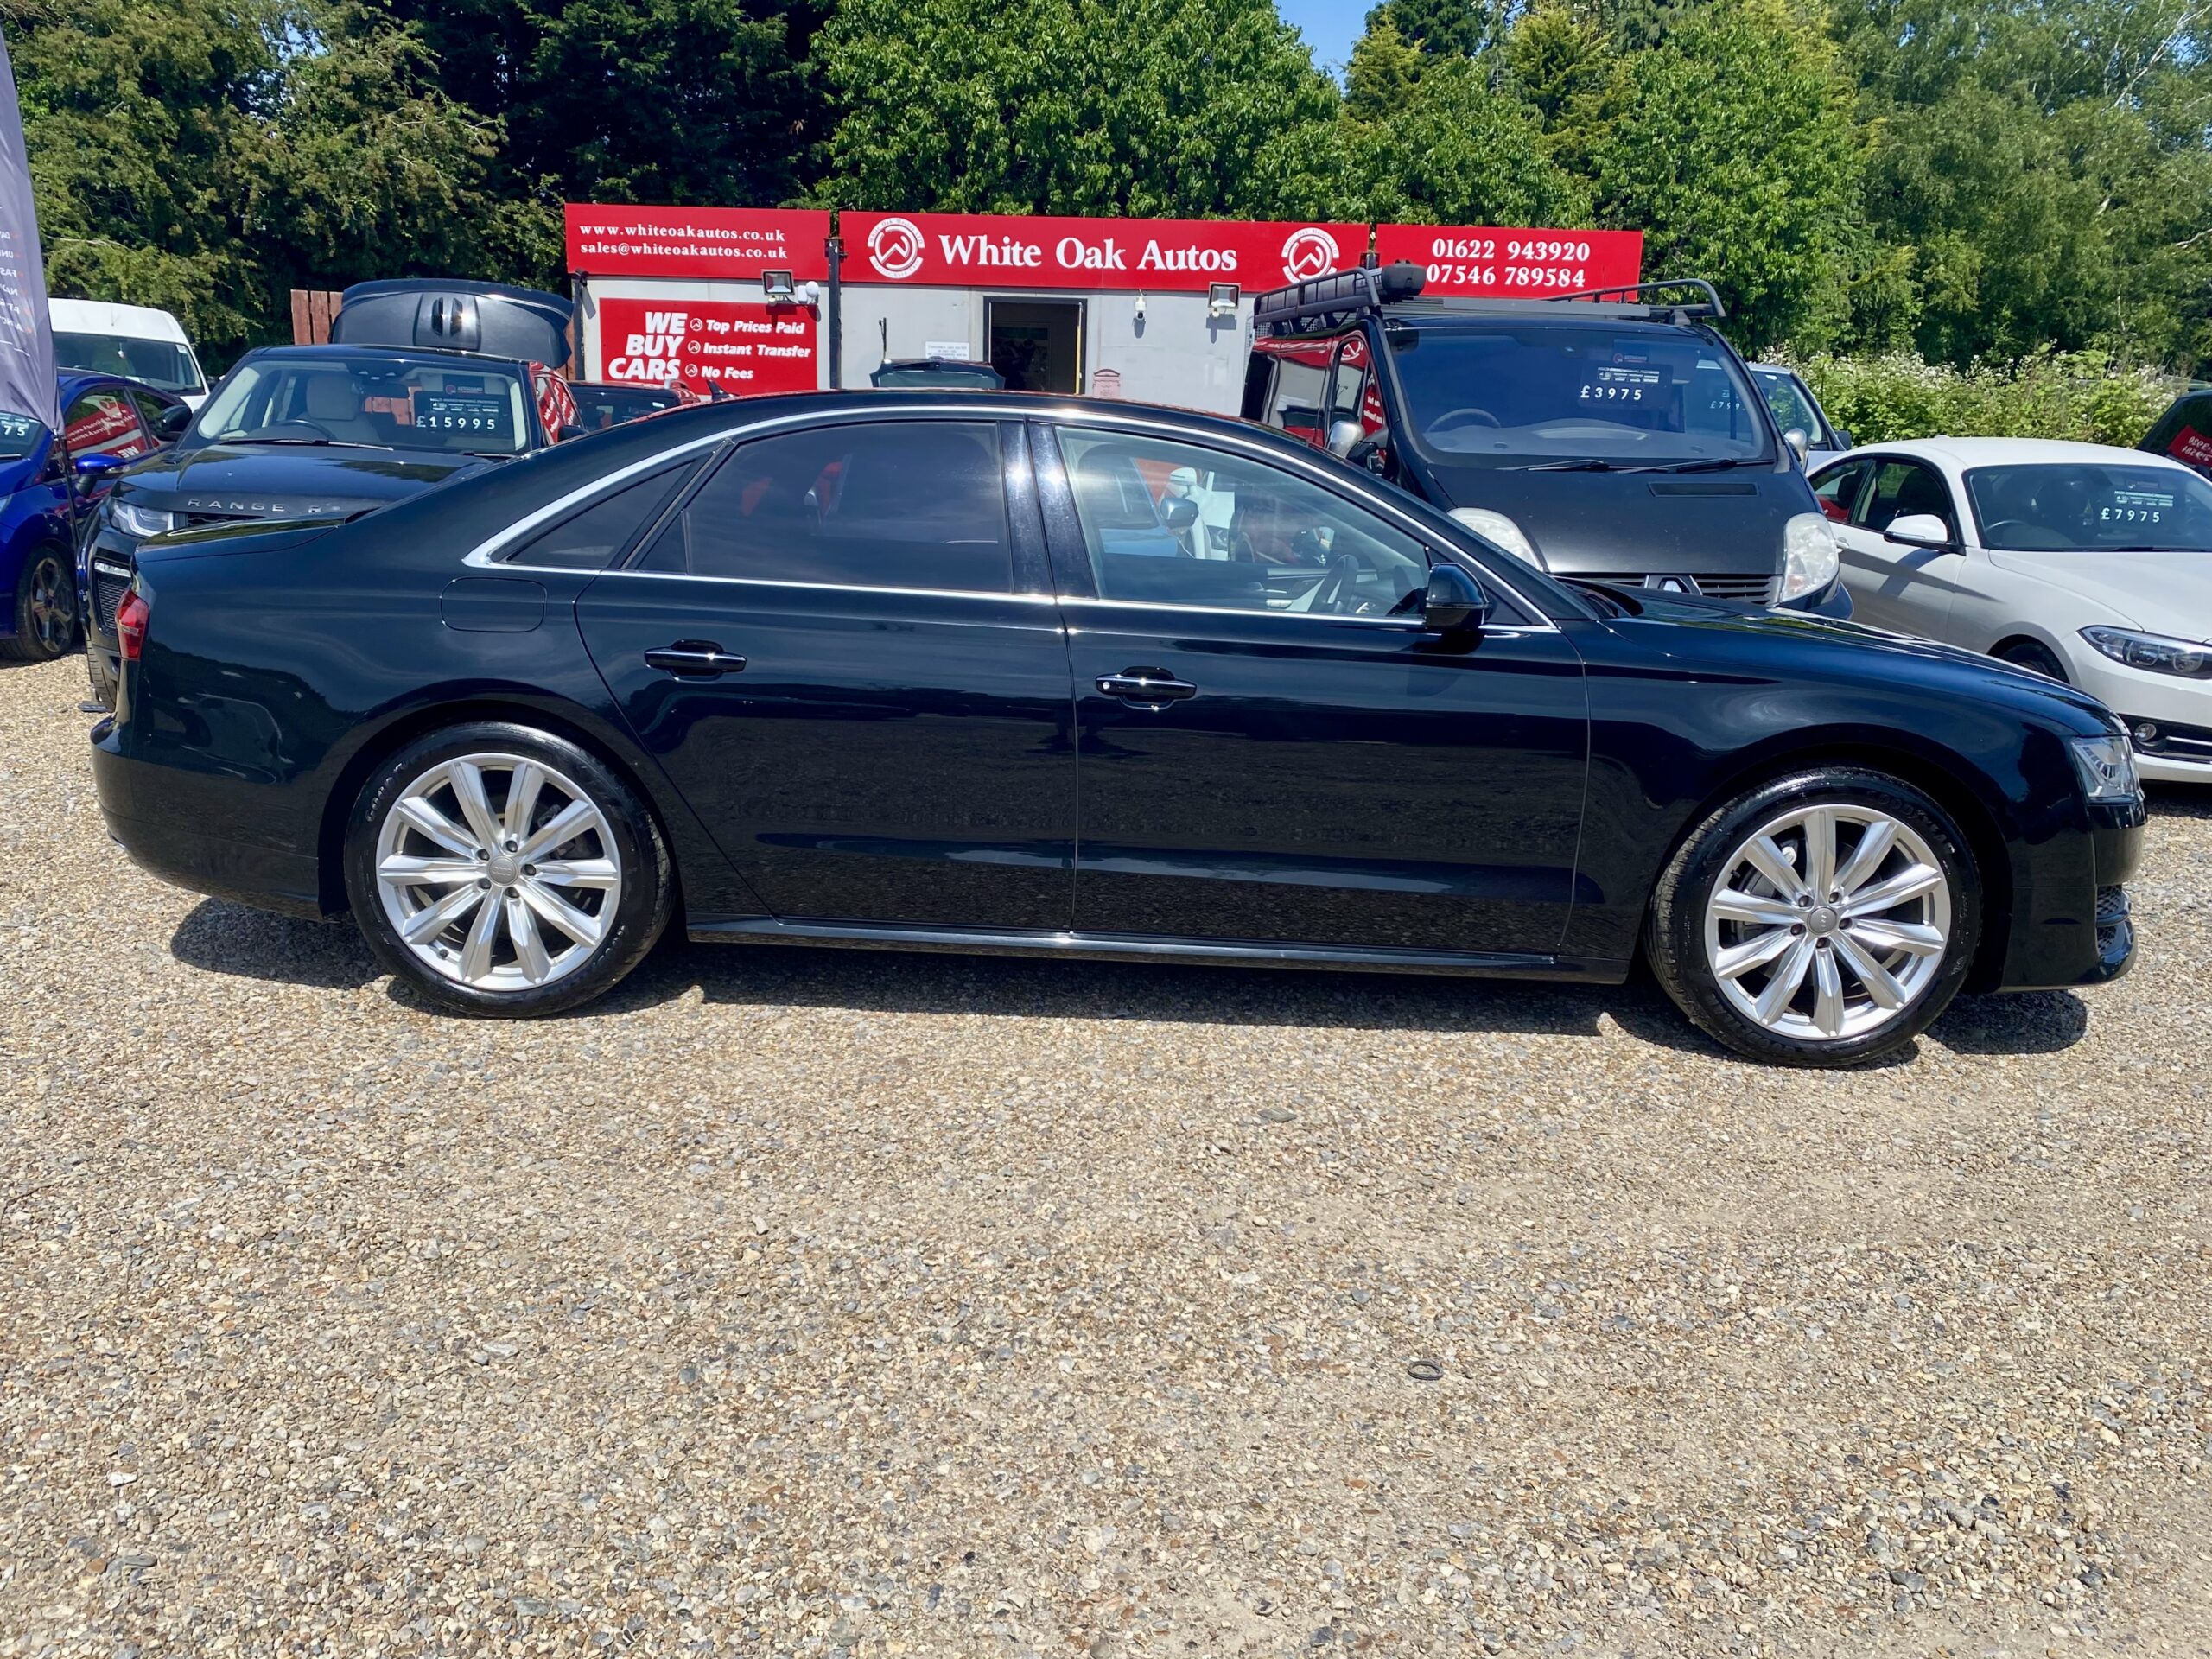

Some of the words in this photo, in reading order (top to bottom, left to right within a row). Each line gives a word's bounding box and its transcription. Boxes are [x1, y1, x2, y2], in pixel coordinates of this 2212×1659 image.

[579, 224, 785, 242] www.whiteoakautos.co.uk
[580, 241, 788, 259] sales@whiteoakautos.co.uk
[938, 234, 1042, 267] White
[1056, 237, 1127, 270] Oak
[1137, 239, 1237, 271] Autos
[1432, 238, 1496, 258] 01622
[1507, 241, 1591, 261] 943920
[1426, 264, 1497, 285] 07546
[1504, 267, 1586, 288] 789584
[645, 312, 688, 334] WE
[705, 319, 730, 334] Top
[734, 321, 772, 334] Prices
[775, 322, 805, 334] Paid
[626, 334, 684, 357] BUY
[702, 342, 752, 356] Instant
[756, 344, 811, 358] Transfer
[608, 358, 681, 380] CARS
[701, 366, 721, 378] No
[723, 367, 753, 379] Fees
[1580, 385, 1642, 401] £3975
[416, 416, 495, 429] £15995
[187, 499, 286, 512] RANGE
[2101, 507, 2160, 524] £7975
